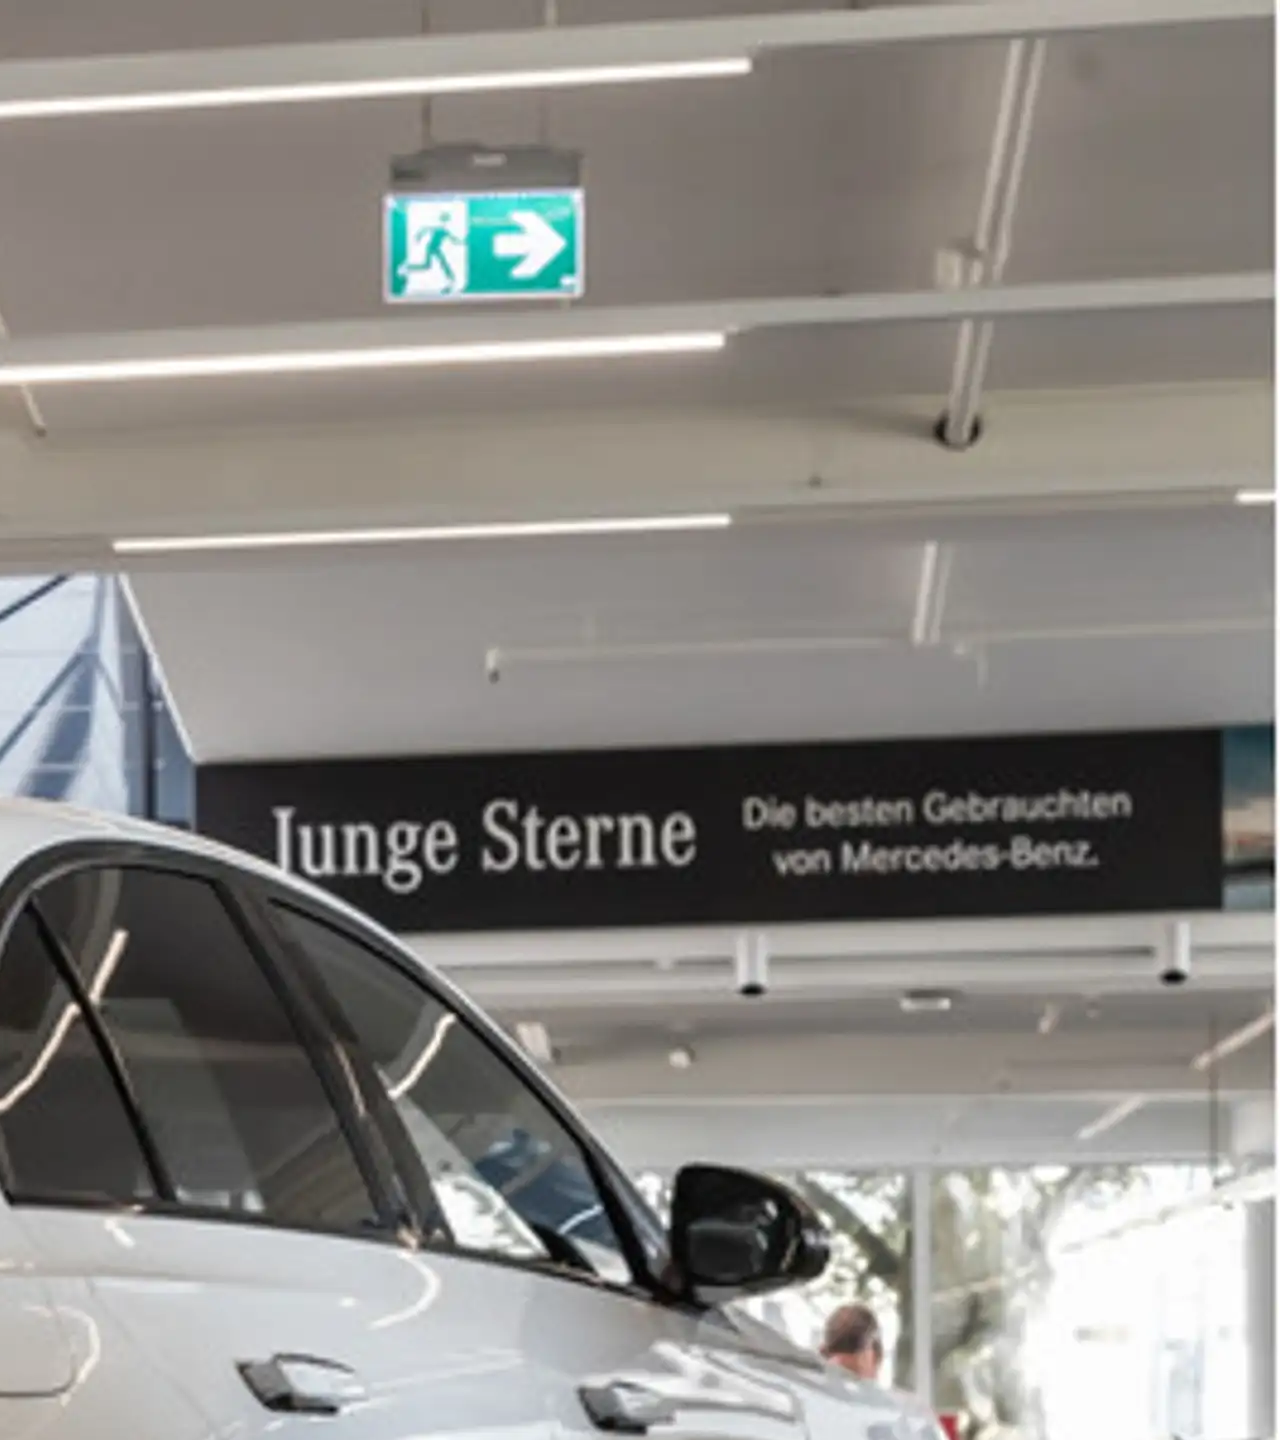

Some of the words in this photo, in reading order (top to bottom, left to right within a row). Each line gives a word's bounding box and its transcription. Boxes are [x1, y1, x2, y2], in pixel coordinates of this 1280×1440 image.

[742, 796, 797, 830] Die
[804, 793, 915, 829] besten
[922, 787, 1133, 825] Gebrauchten
[272, 805, 459, 894] Junge
[481, 798, 697, 873] Sterne
[771, 847, 832, 876] von
[842, 834, 1101, 874] Mercedes-Benz.
